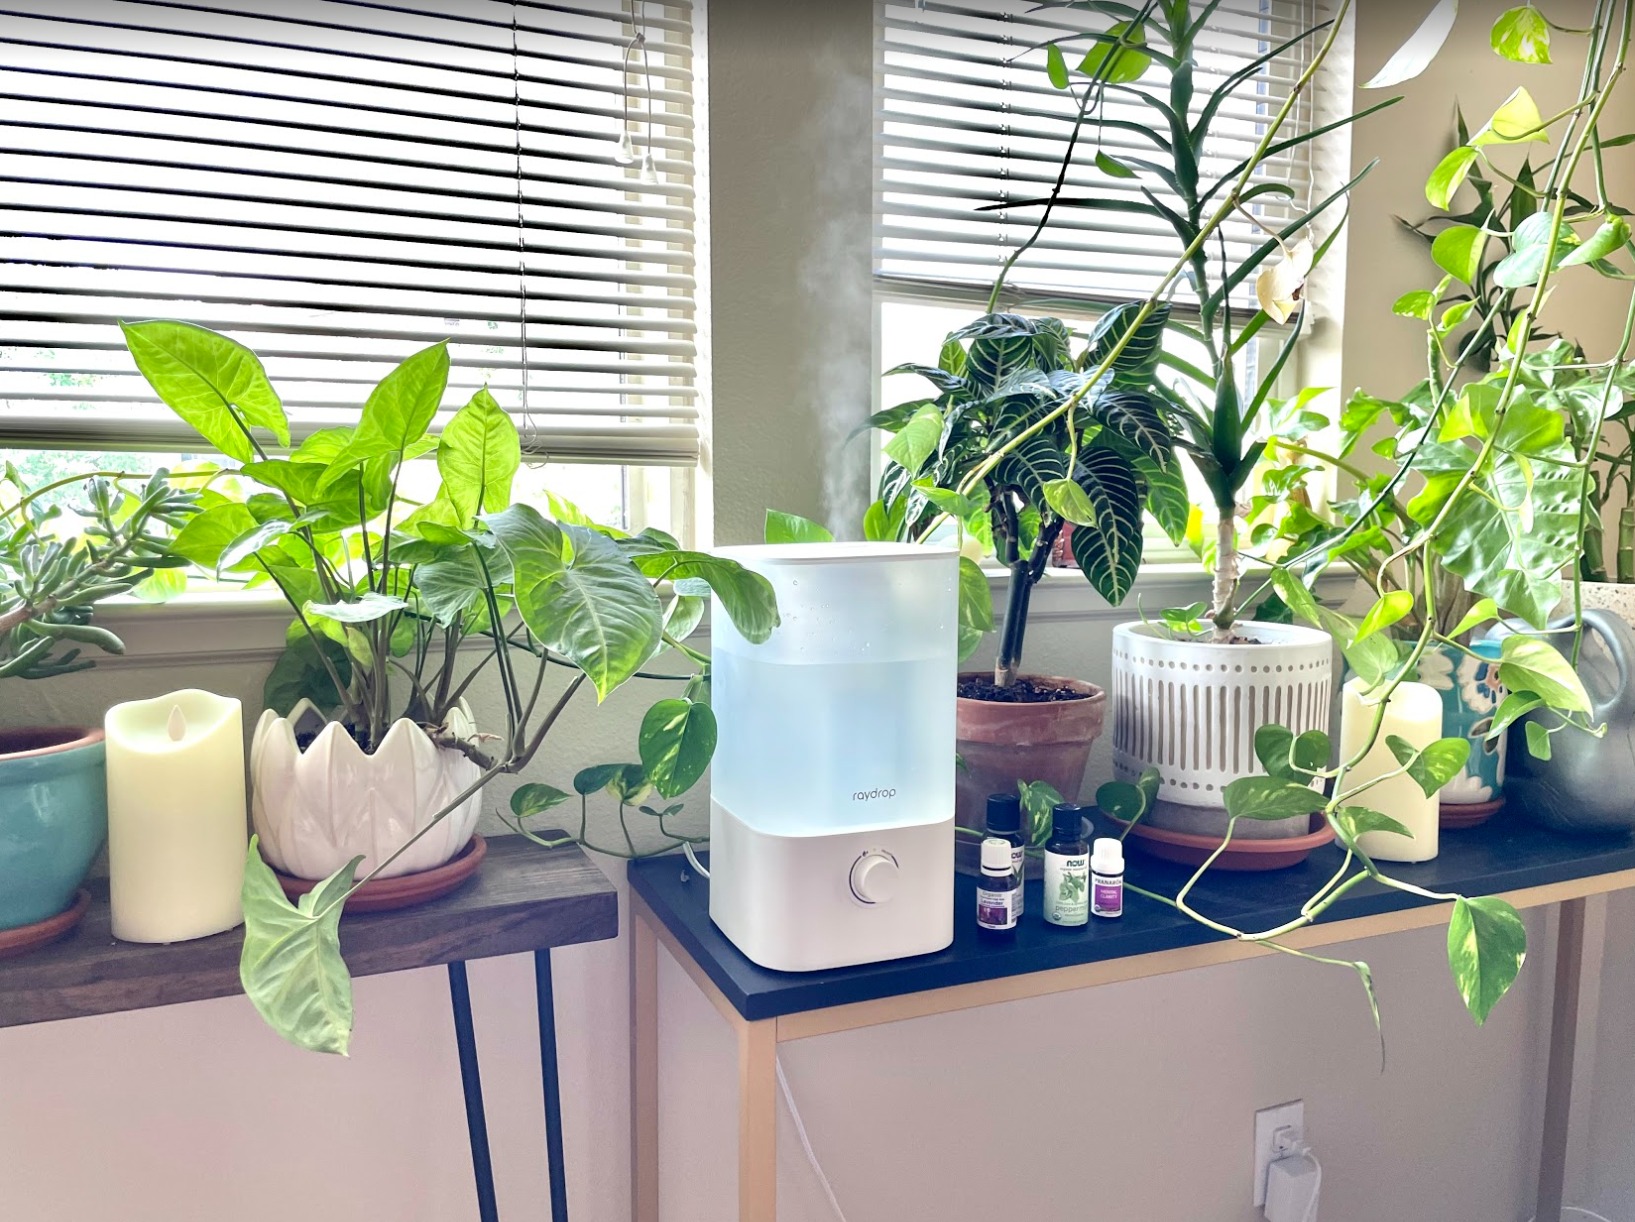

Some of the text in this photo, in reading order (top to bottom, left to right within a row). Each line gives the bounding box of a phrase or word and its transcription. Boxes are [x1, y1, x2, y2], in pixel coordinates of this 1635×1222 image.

[852, 788, 897, 802] raydrop
[1011, 850, 1023, 860] ow
[1066, 859, 1085, 868] now
